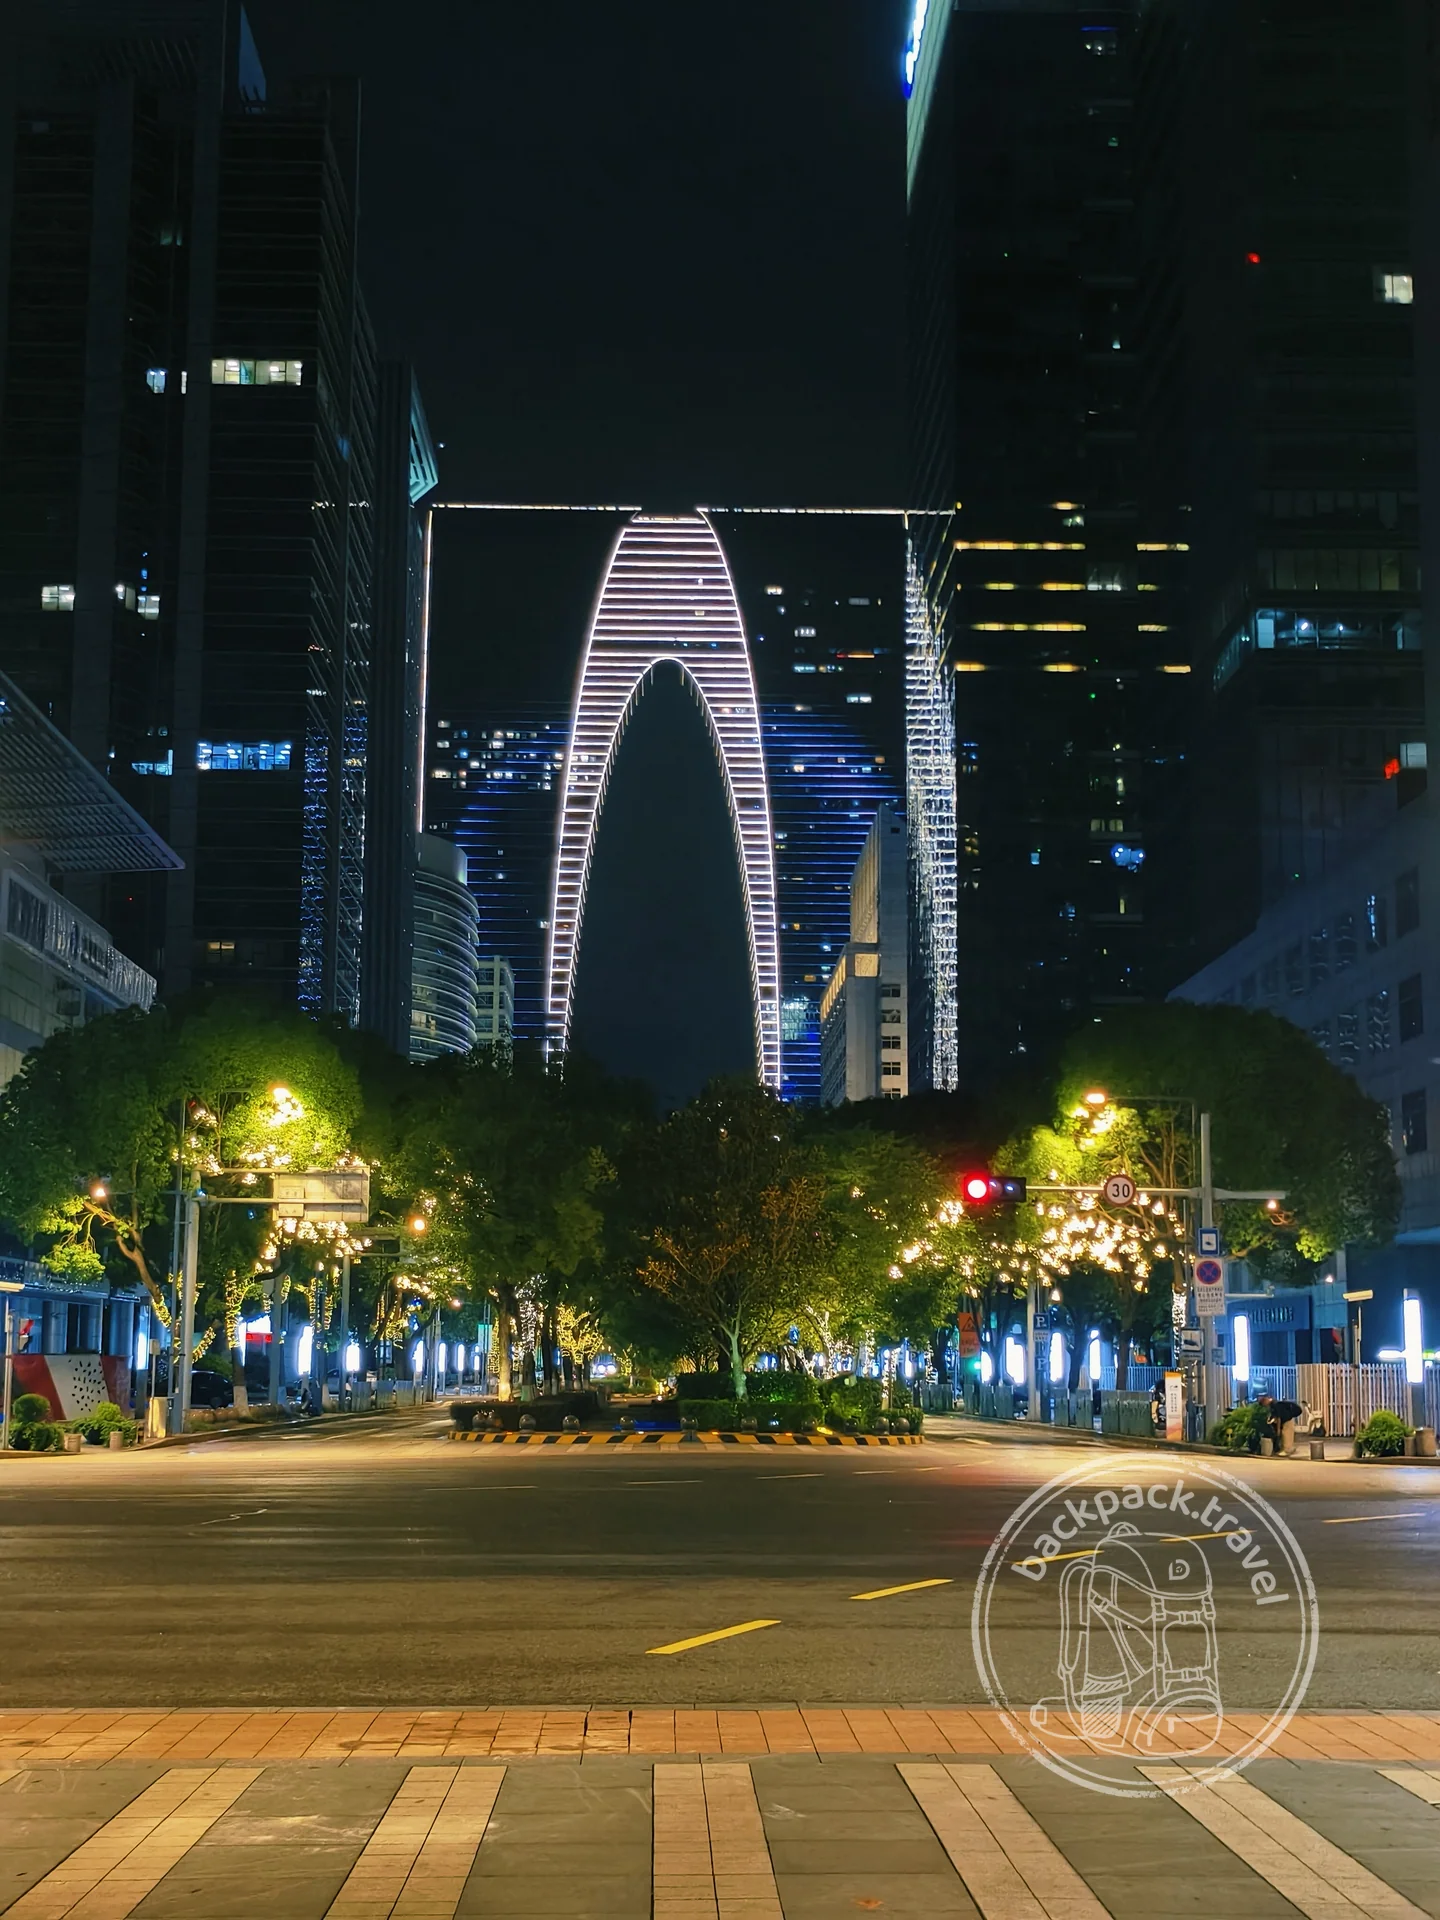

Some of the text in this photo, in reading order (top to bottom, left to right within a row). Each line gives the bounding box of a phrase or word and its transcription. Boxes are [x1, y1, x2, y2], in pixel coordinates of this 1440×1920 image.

[1112, 1183, 1130, 1198] 30
[1036, 1316, 1046, 1328] P
[1037, 1358, 1046, 1371] P
